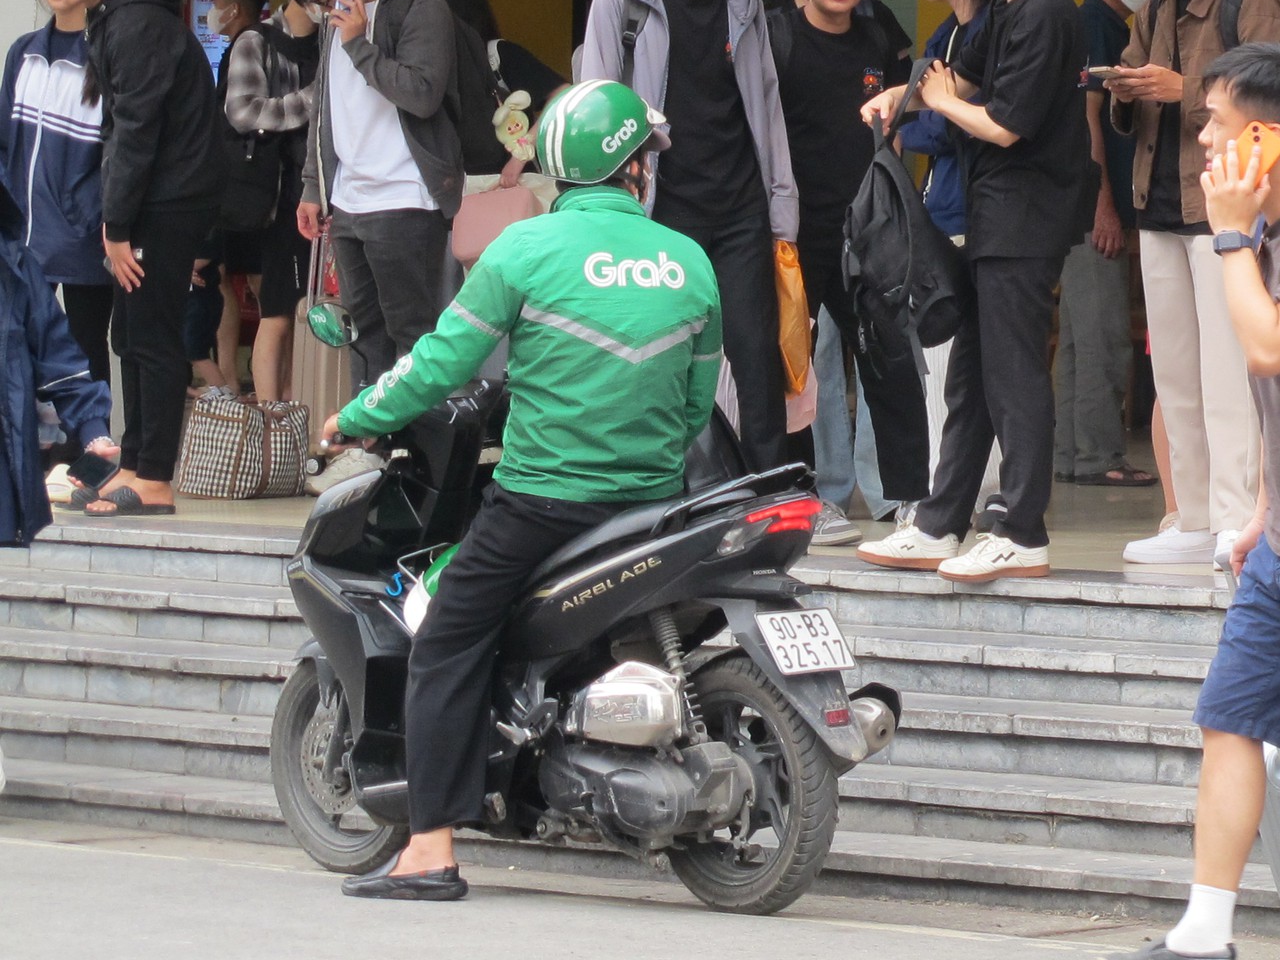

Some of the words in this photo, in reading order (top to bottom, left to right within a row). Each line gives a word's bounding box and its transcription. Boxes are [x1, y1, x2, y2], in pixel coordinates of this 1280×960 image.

[601, 118, 638, 154] Grab
[583, 251, 686, 290] Grab
[769, 613, 830, 640] 90-B3
[776, 639, 848, 670] 325.17
